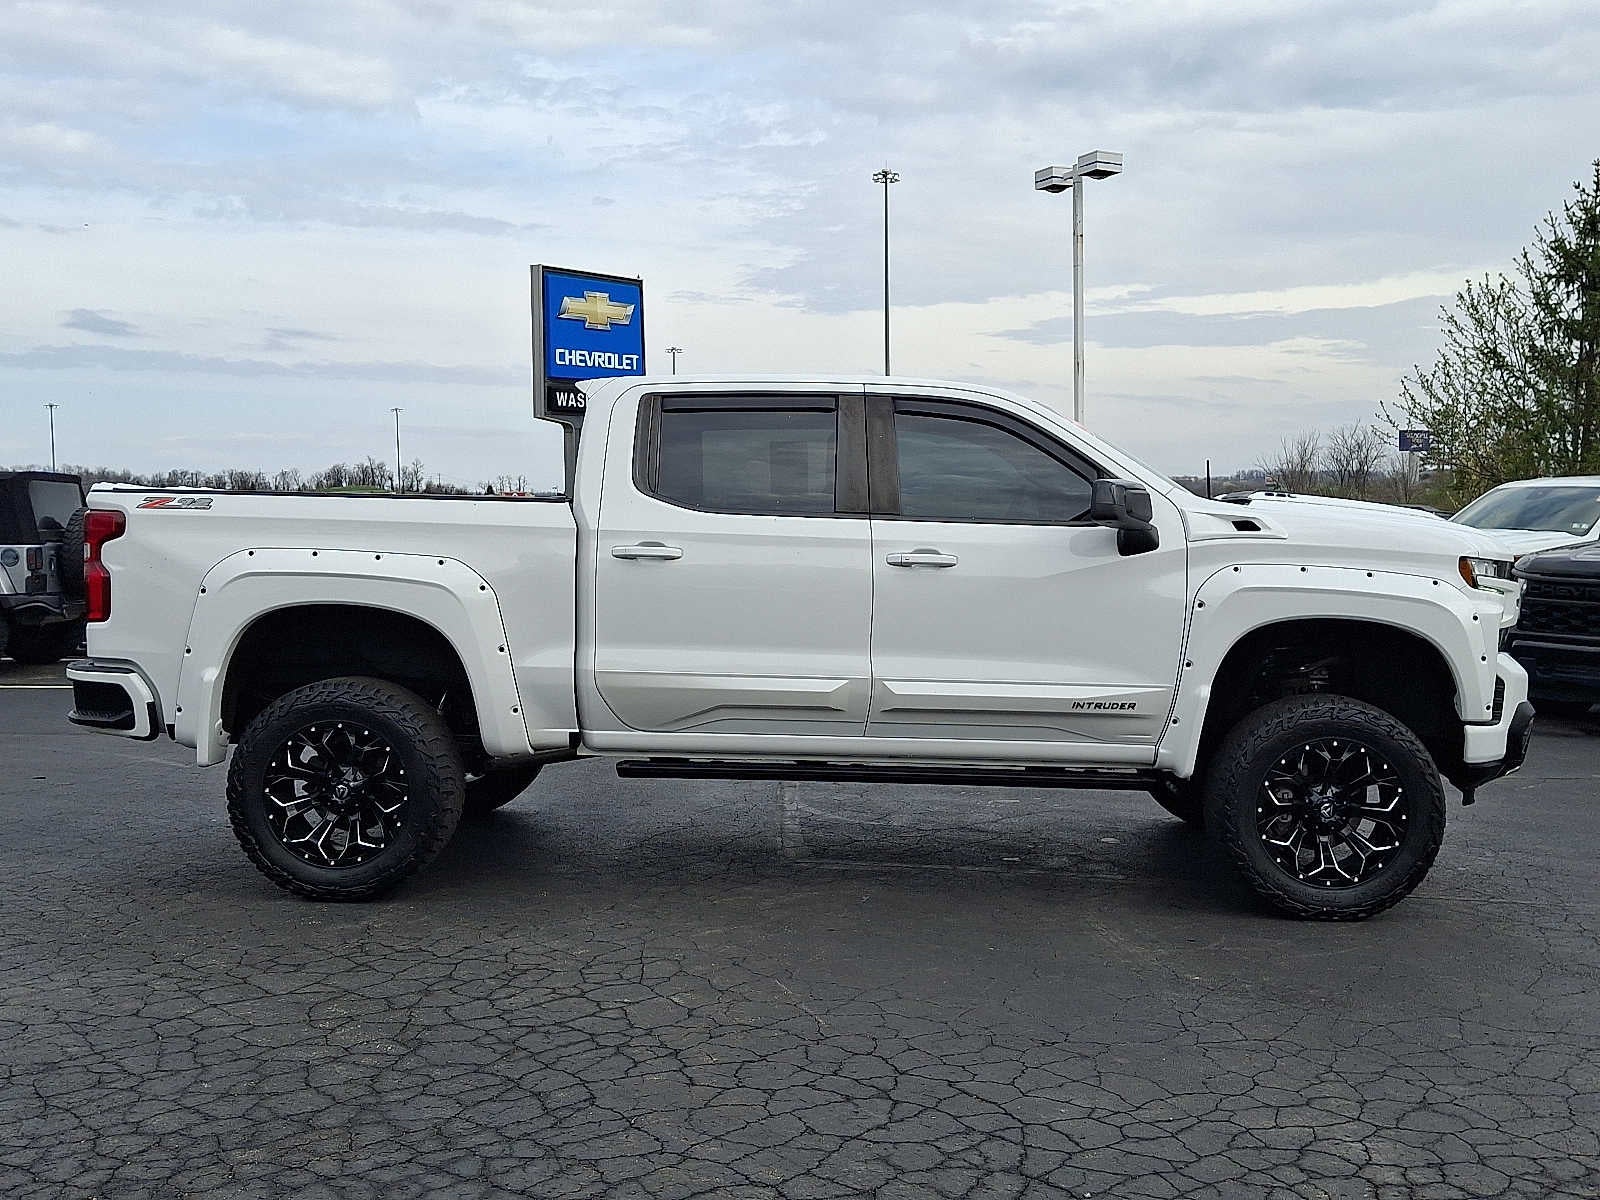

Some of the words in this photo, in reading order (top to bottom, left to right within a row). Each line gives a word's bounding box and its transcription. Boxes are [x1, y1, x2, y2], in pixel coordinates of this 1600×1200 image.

[555, 348, 639, 370] CHEVROLET
[556, 391, 585, 408] WAS
[1071, 701, 1137, 711] INTRUDER
